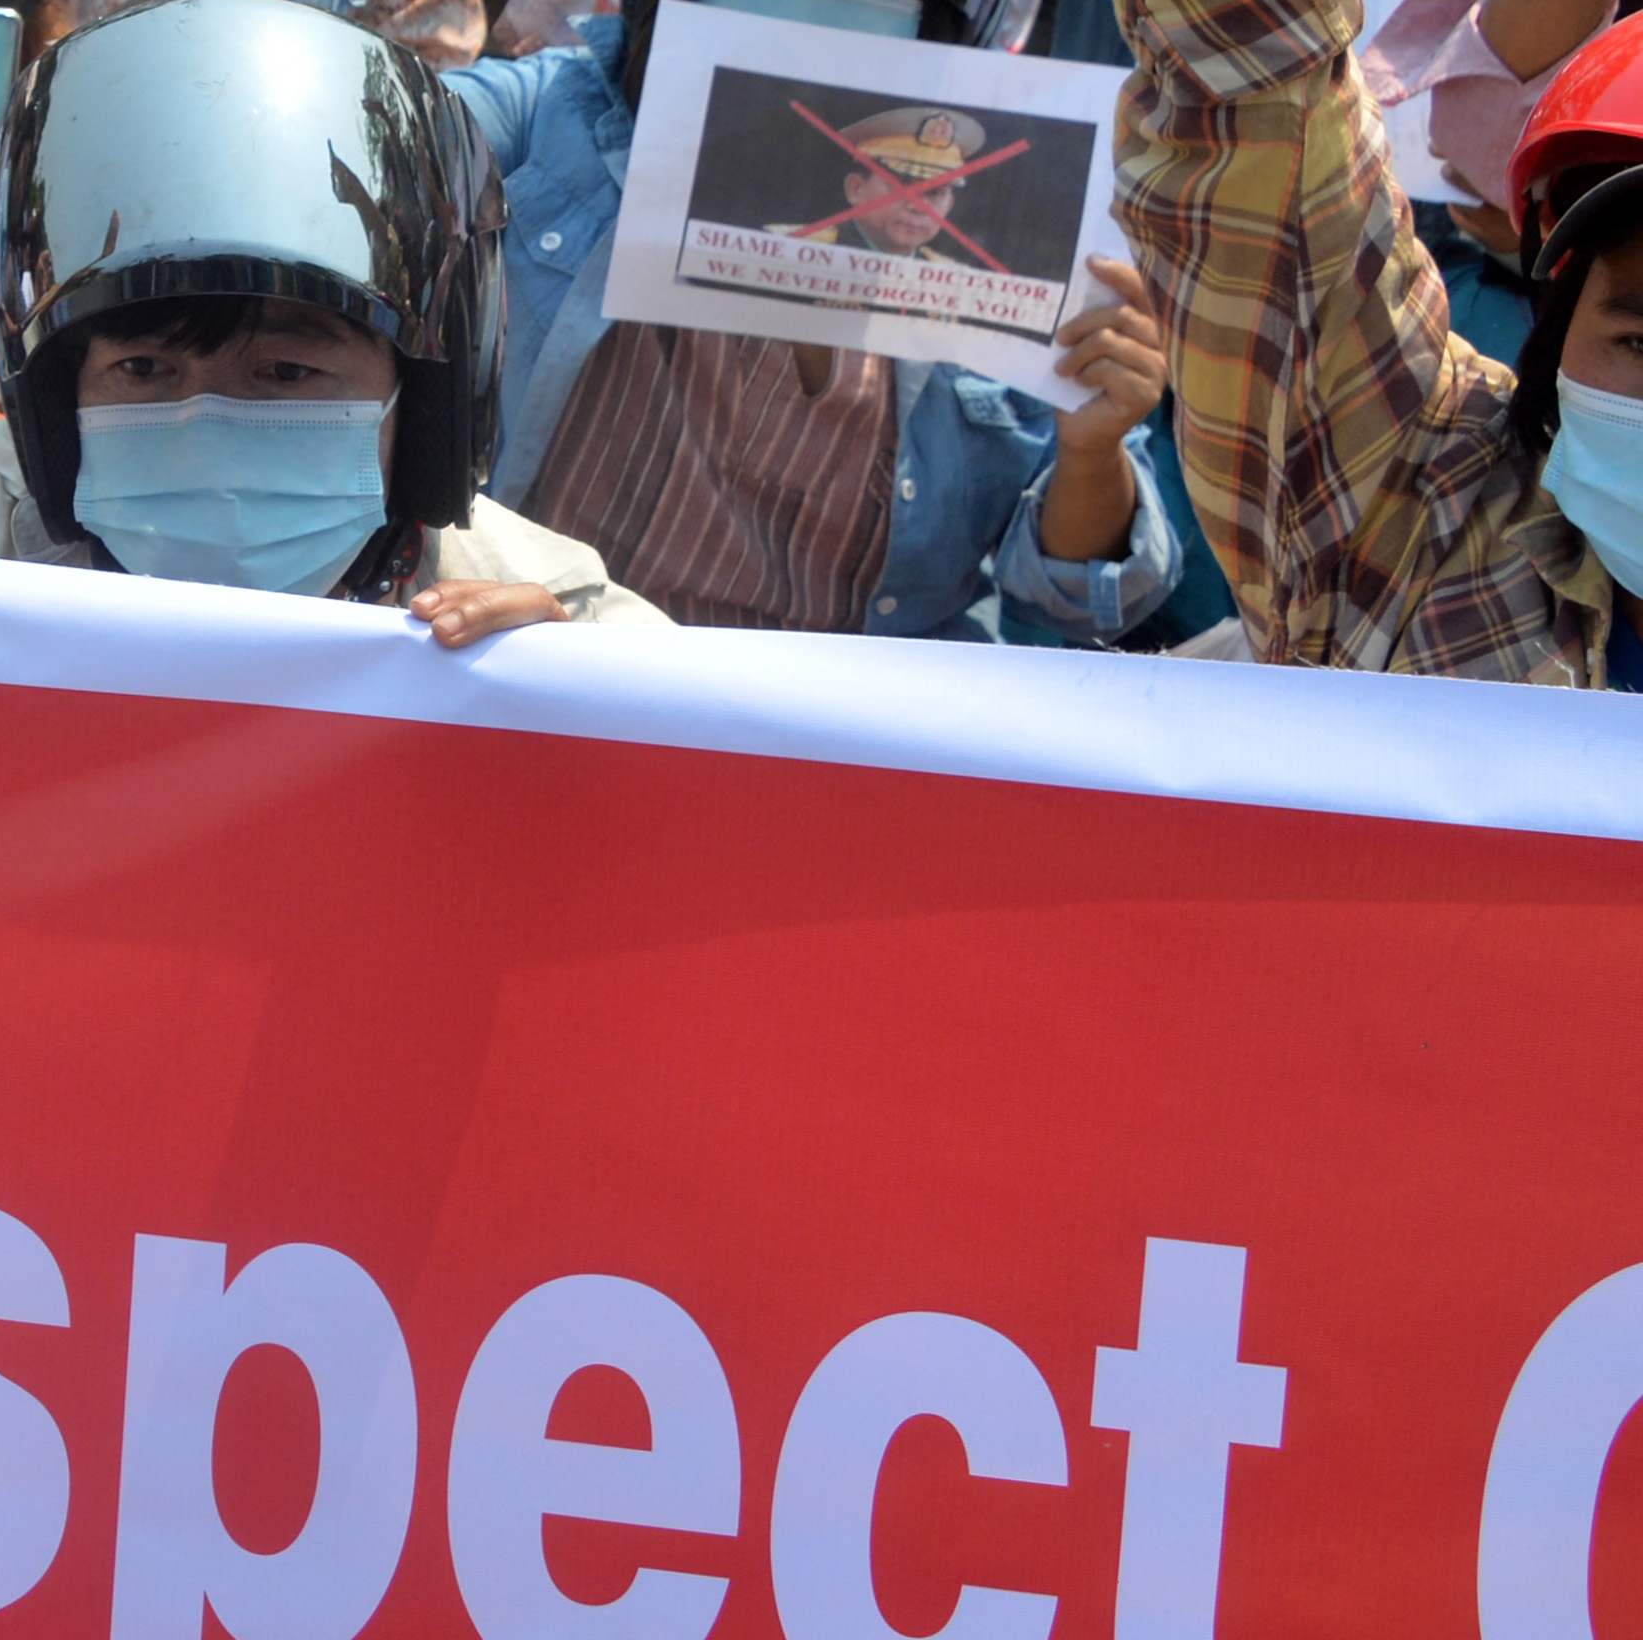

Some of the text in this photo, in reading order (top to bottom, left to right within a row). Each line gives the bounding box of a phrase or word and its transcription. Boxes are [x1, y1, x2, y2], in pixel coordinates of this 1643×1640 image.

[697, 227, 1050, 302] SHAME ON YOU, DICTATOR
[706, 259, 1027, 321] WE NEVER FORGIVE YOU
